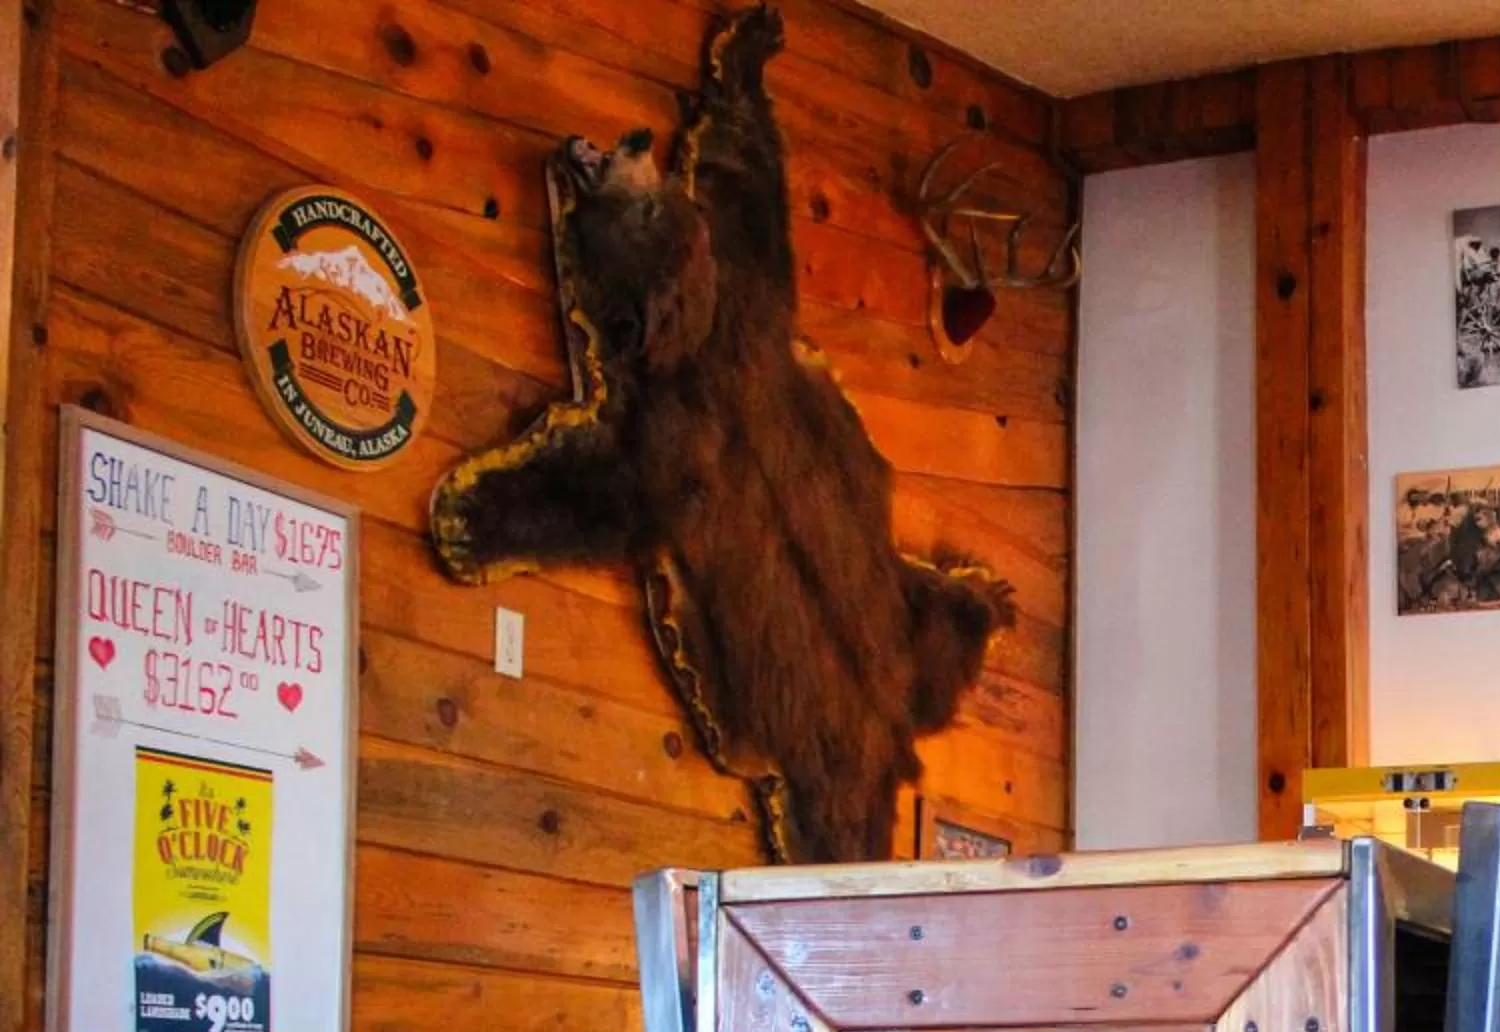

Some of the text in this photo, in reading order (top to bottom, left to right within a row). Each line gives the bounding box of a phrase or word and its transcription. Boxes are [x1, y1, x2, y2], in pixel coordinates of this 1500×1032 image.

[293, 201, 408, 279] HANDCRAFTED
[268, 286, 413, 378] ALASKAN
[301, 331, 389, 391] BREWING
[277, 375, 296, 403] IN
[357, 423, 408, 458] ALASKA
[86, 452, 343, 571] SHAKE A DAY $1675
[167, 530, 259, 576] BOULDER BAR
[88, 568, 193, 646] QUEEN
[222, 601, 325, 674] HEARTS
[156, 831, 249, 876] O'CLOCK
[178, 798, 232, 833] FIVE
